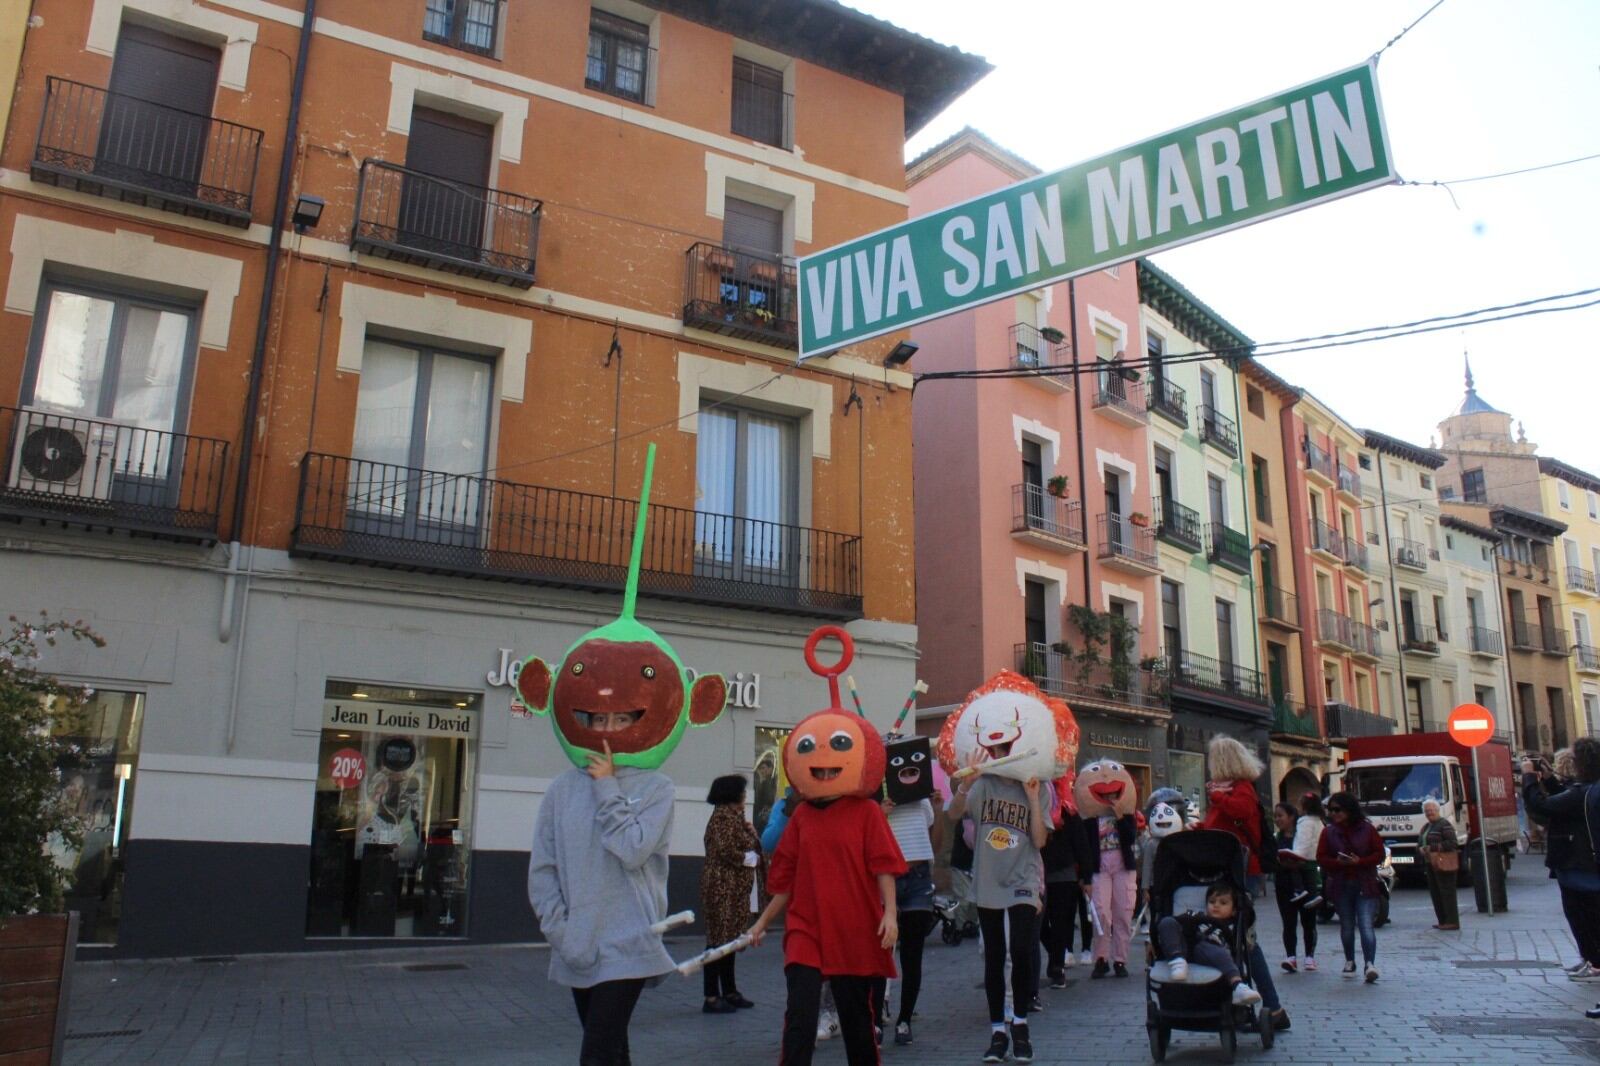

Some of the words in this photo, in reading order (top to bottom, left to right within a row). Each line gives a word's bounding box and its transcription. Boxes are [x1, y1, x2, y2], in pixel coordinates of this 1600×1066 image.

[806, 234, 923, 339] VIVA
[941, 184, 1066, 297] SAN
[1086, 80, 1375, 254] MARTIN
[331, 705, 368, 724] Jean
[376, 709, 420, 728] Louis
[428, 712, 470, 733] David
[332, 756, 363, 780] 20%
